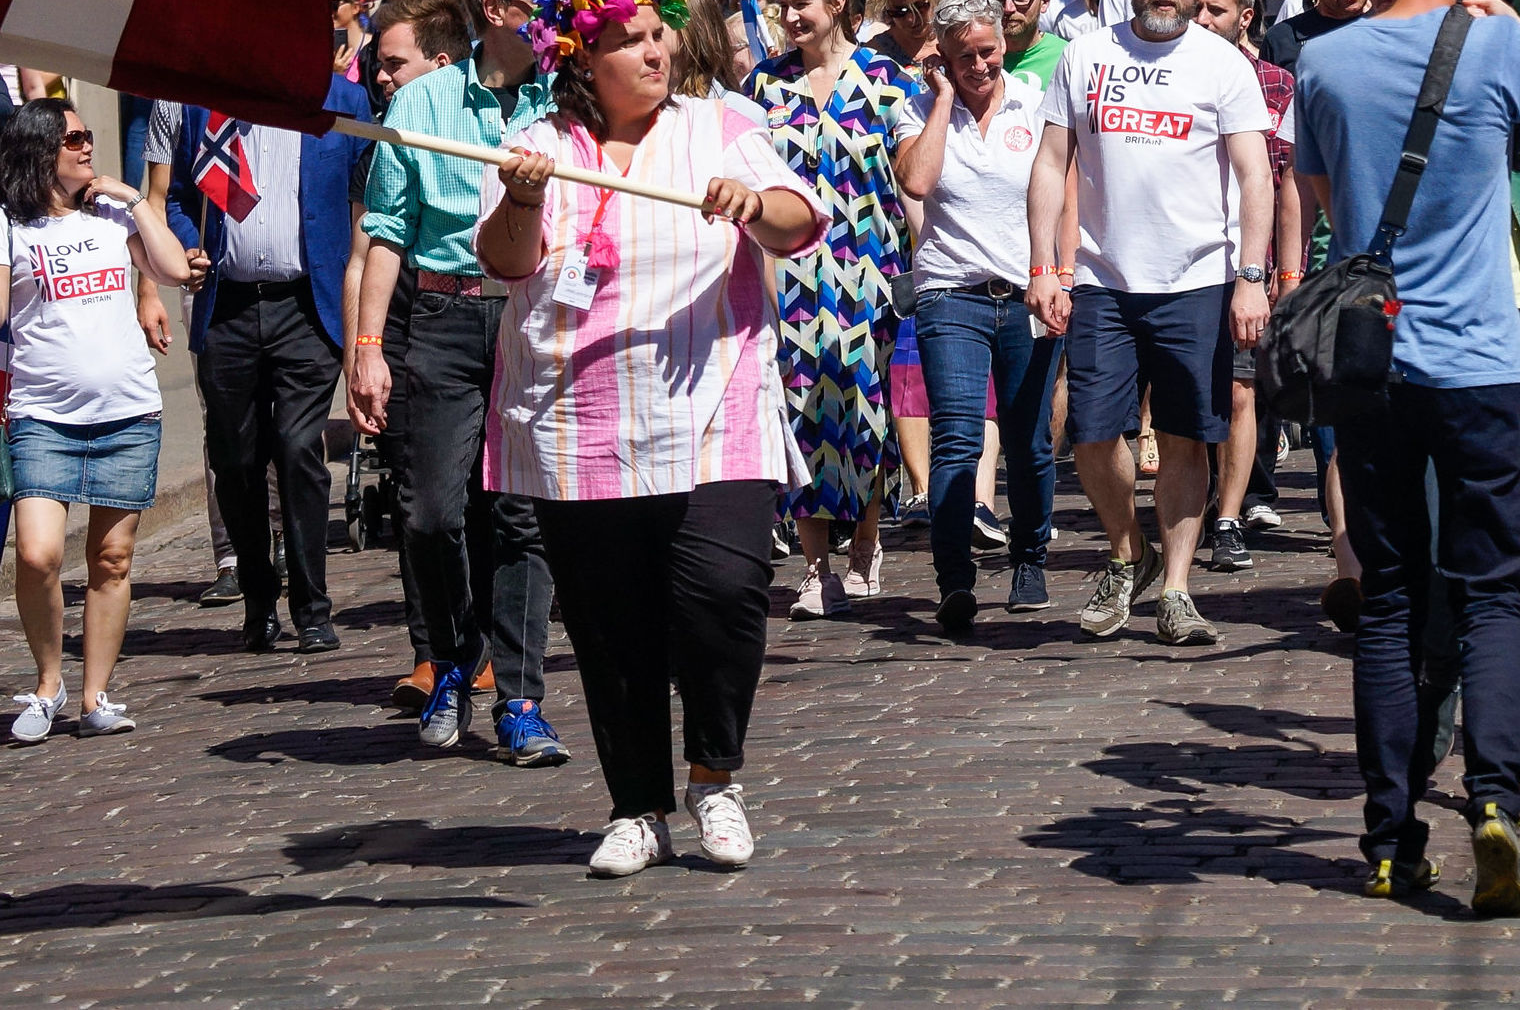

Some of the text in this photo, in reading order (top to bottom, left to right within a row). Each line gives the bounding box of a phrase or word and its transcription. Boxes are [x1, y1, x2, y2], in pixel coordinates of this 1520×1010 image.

[1108, 65, 1172, 86] LOVE
[1103, 84, 1126, 102] IS
[1103, 108, 1190, 137] GREAT
[1124, 136, 1161, 146] BRITAIN
[44, 238, 99, 257] LOVE
[48, 258, 69, 275] IS
[56, 270, 124, 297] GREAT
[81, 294, 112, 306] BRITAIN
